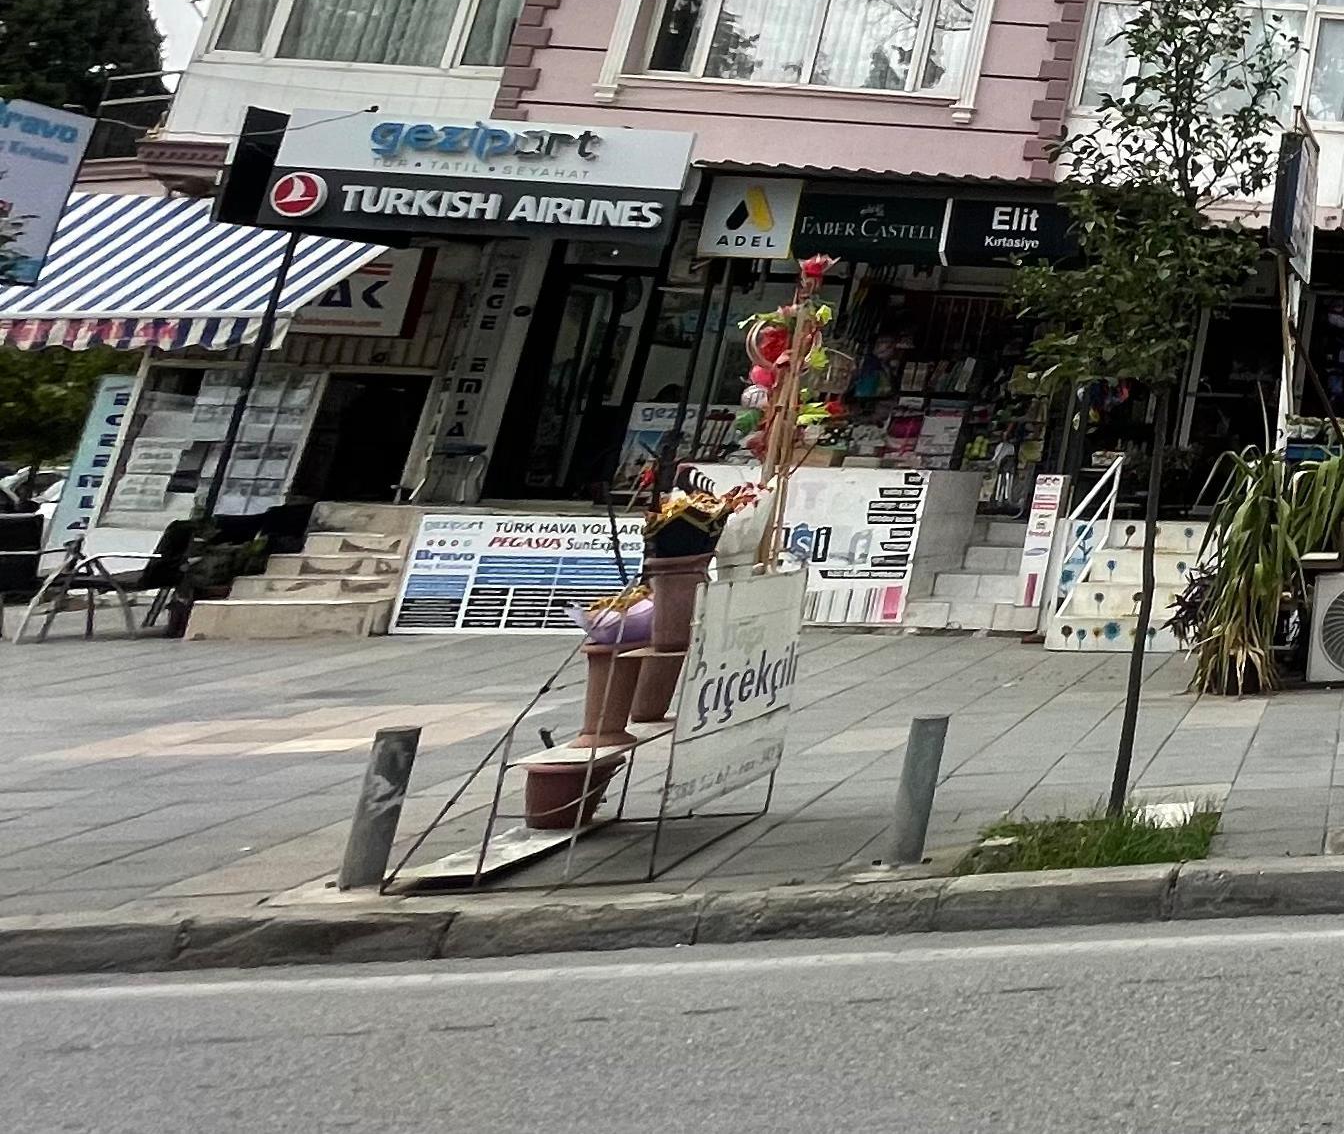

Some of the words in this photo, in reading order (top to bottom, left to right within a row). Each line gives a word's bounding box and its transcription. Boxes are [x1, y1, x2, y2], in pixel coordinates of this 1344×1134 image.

[501, 164, 591, 180] SEYAHAT
[342, 184, 503, 221] TURKISH
[507, 195, 666, 229] AIRLINES
[992, 206, 1040, 232] Elit
[716, 235, 777, 249] ADEL
[495, 521, 535, 535] TÜRK
[538, 522, 578, 535] HAVA
[566, 537, 643, 554] SunExpess
[692, 641, 801, 732] çiçekçili
